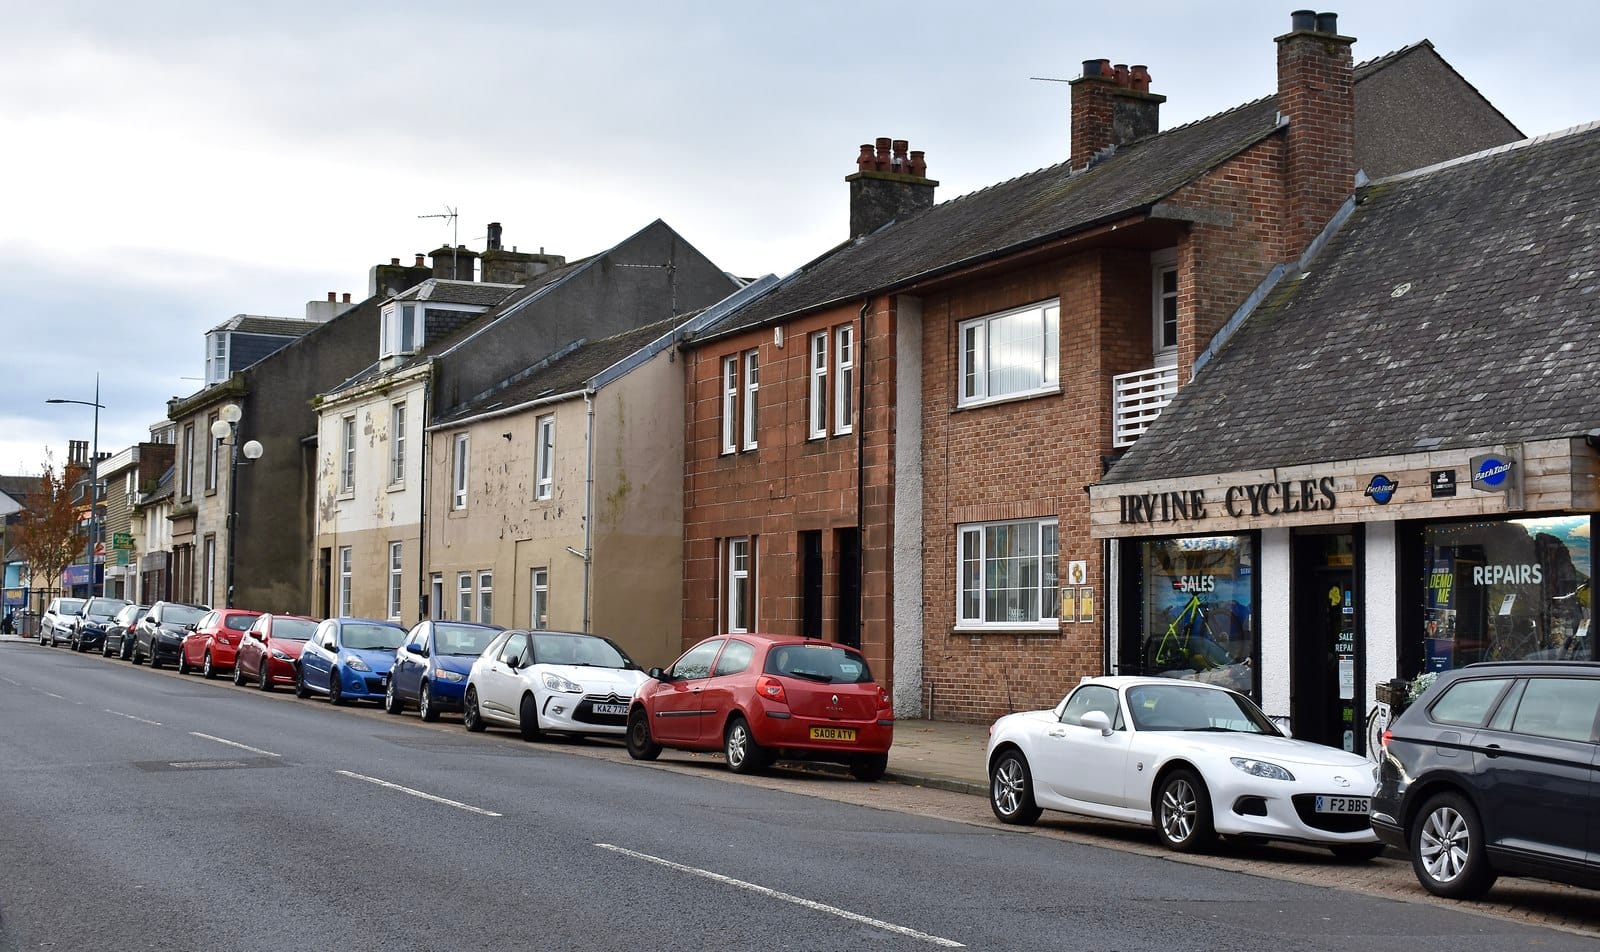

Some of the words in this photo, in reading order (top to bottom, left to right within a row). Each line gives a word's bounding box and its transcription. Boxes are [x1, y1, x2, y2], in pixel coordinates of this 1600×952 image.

[1118, 489, 1207, 525] IRVINE
[1225, 476, 1337, 518] CYCLES
[1429, 573, 1453, 588] DEMO
[1473, 563, 1543, 586] REPAIRS
[1180, 575, 1215, 592] SALES
[1437, 588, 1451, 602] ME
[597, 704, 612, 713] KAZ
[814, 729, 835, 739] SA08
[837, 730, 853, 739] ATV
[1330, 798, 1345, 812] F2
[1347, 799, 1368, 812] BBS
